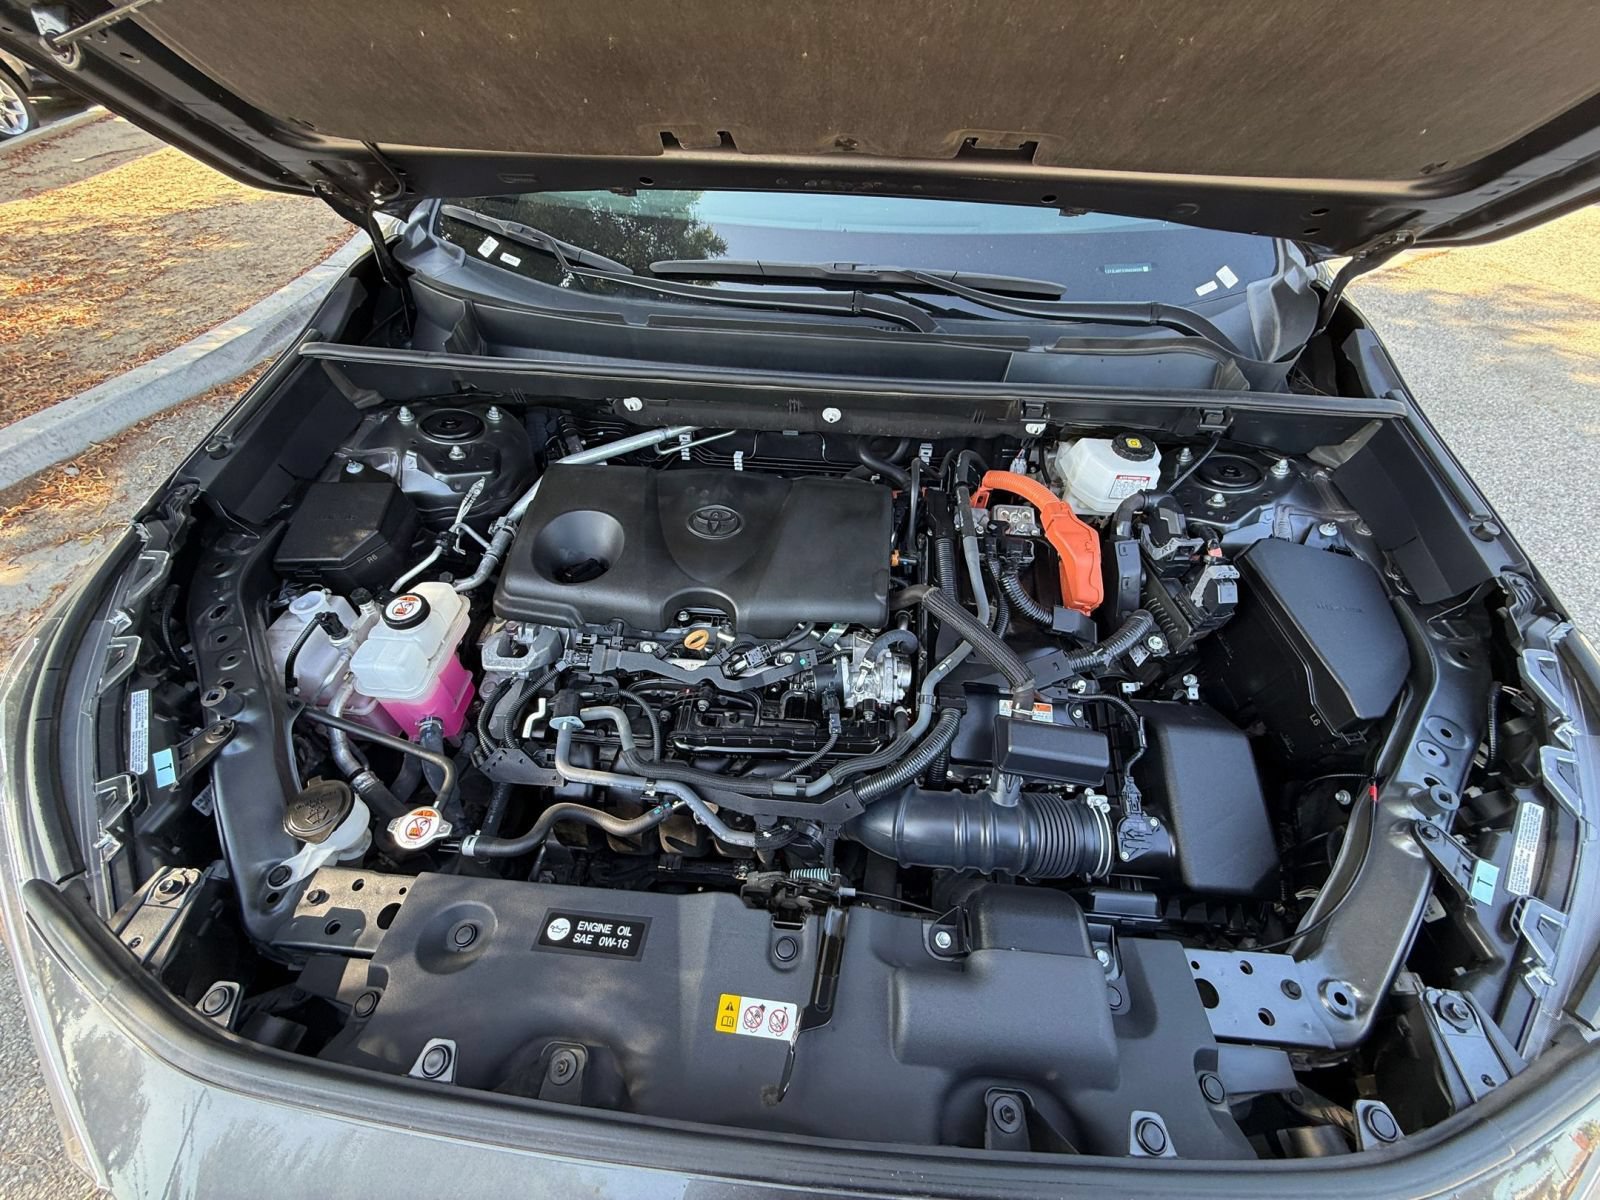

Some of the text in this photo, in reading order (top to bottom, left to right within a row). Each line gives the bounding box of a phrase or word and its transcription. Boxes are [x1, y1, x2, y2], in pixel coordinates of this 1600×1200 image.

[1309, 713, 1321, 726] L6
[577, 921, 632, 937] ENGINE OIL
[572, 933, 629, 949] SAE 0W-16
